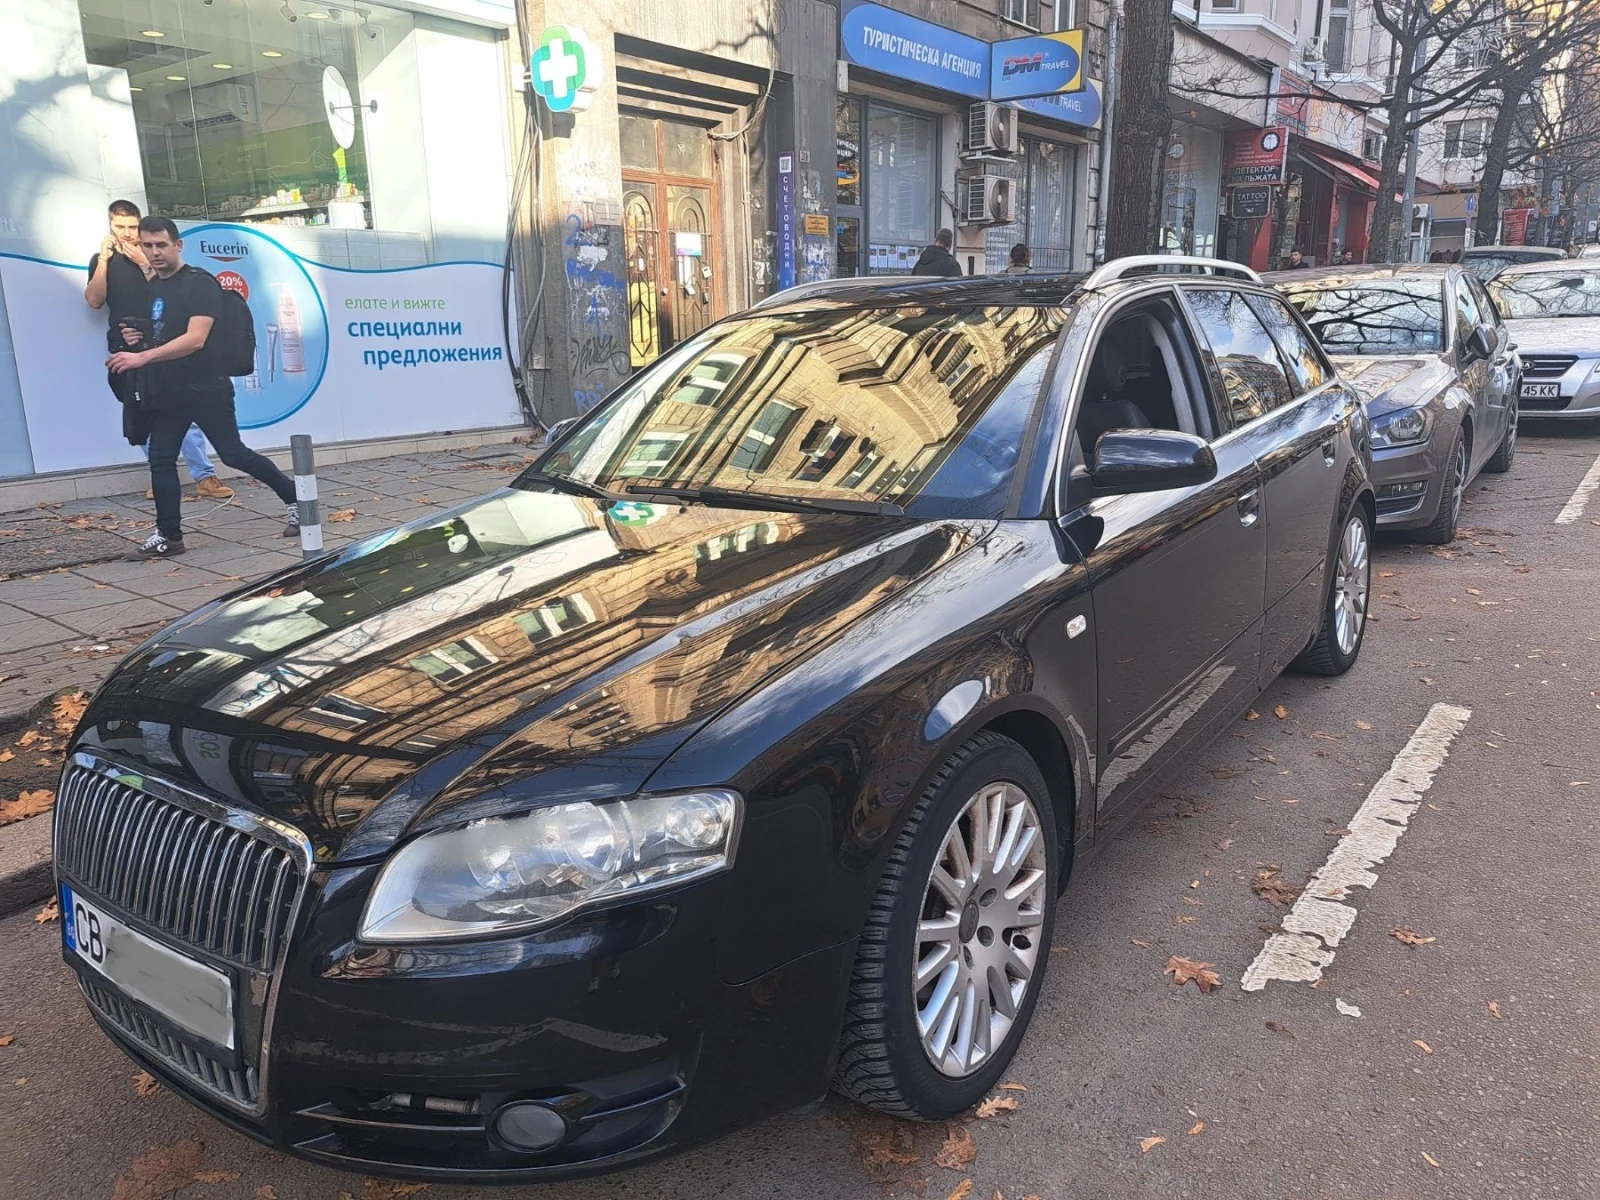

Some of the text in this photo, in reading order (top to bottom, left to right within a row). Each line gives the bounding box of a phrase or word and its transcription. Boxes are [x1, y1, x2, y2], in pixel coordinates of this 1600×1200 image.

[863, 26, 982, 79] ТУРИСТИЧЕСКА АГЕНЦИЯ
[1041, 60, 1070, 71] TRAVEL
[1060, 96, 1083, 112] TRAVEL
[1235, 165, 1276, 175] ДЕТЕКТОР
[1237, 192, 1267, 200] TATTOO
[200, 240, 249, 255] Eucerin
[345, 298, 445, 309] елате и вижте
[347, 321, 462, 340] специални
[363, 346, 502, 371] предложения
[1523, 385, 1537, 396] 45
[75, 902, 104, 964] CB
